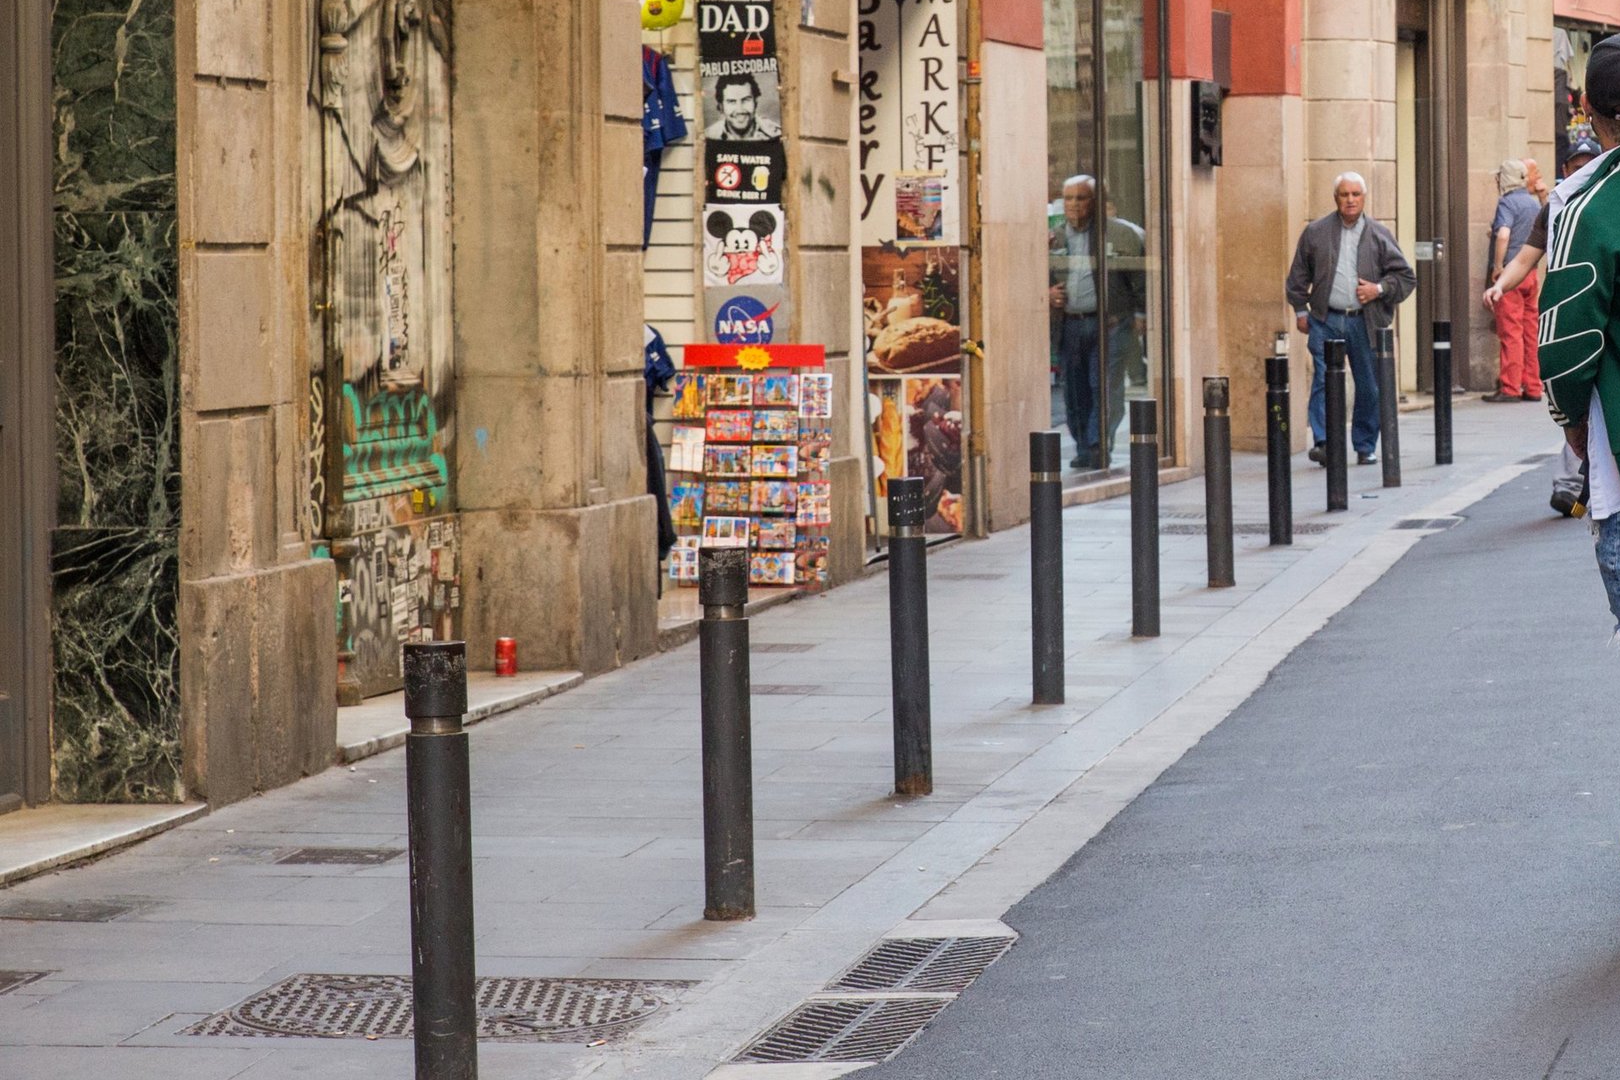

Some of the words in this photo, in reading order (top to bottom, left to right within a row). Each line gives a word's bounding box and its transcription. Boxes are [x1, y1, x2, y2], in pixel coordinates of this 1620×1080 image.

[700, 4, 770, 32] DAD
[700, 61, 729, 76] PABLO
[731, 57, 777, 75] ESCOBAR
[716, 153, 739, 163] SAVE
[740, 154, 771, 165] WATER
[716, 188, 741, 199] DRINK
[741, 191, 760, 200] BEER
[719, 320, 771, 334] NASA
